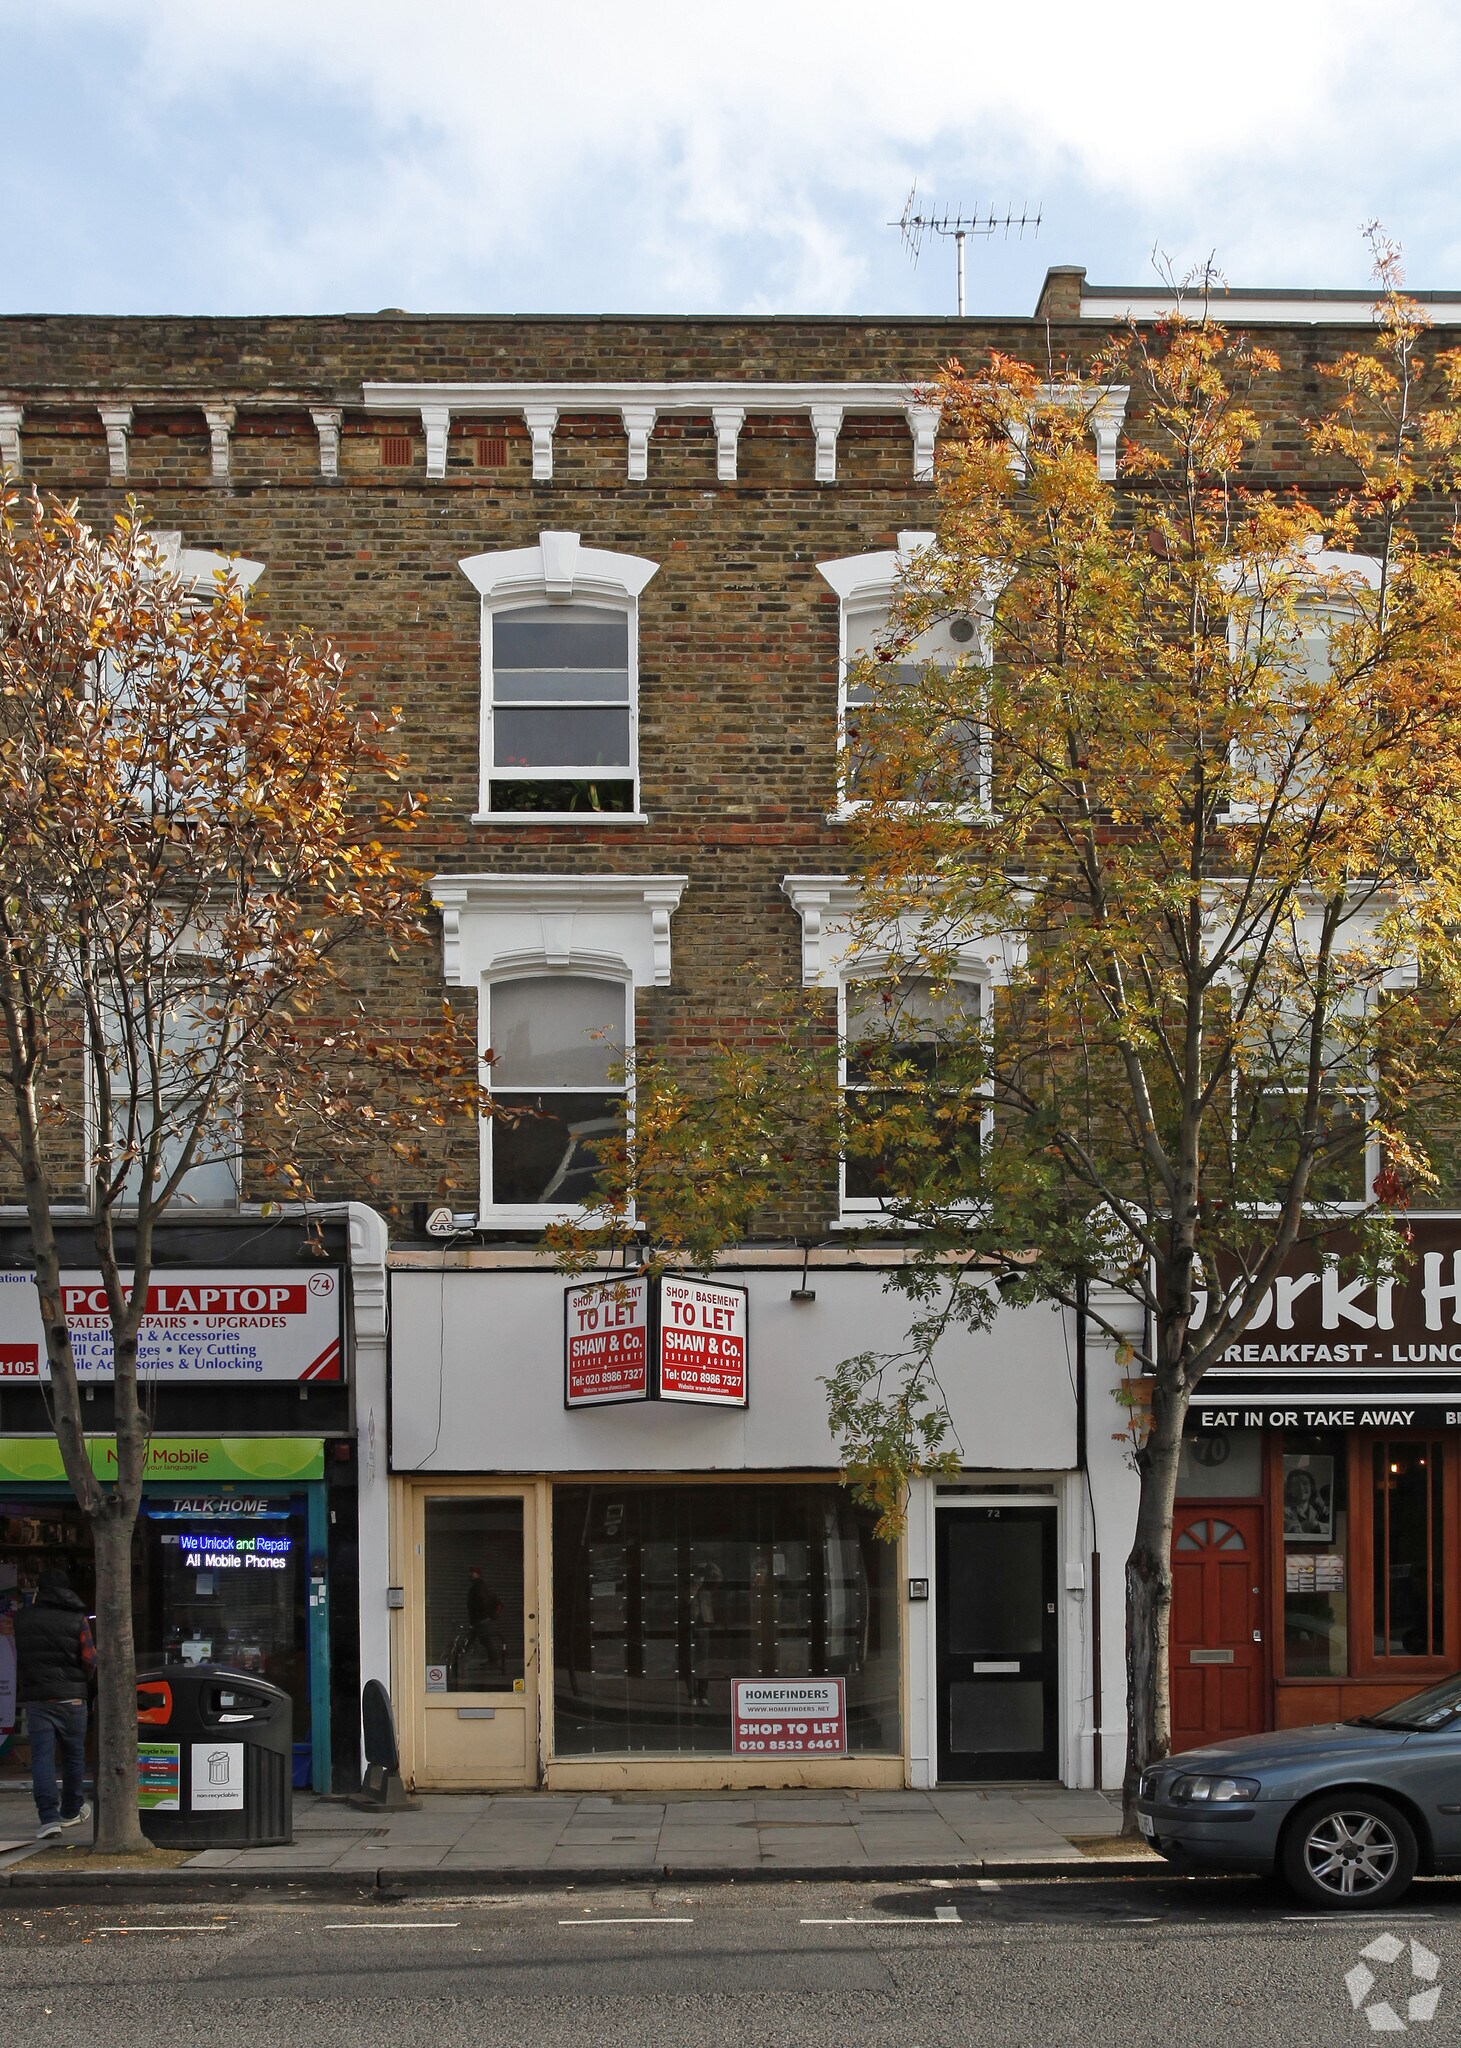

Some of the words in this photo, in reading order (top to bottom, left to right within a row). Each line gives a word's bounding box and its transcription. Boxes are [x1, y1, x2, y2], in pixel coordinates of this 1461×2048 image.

[312, 1279, 330, 1290] 74
[66, 1289, 109, 1312] PC
[157, 1288, 290, 1312] LAPTOP
[573, 1295, 593, 1308] SHOP
[600, 1286, 642, 1303] BASENT
[666, 1286, 689, 1300] SHOP
[696, 1291, 739, 1308] BASEMENT
[67, 1317, 109, 1328] SALES
[139, 1317, 187, 1328] EPAIRS
[206, 1316, 287, 1328] UPGRADES
[578, 1308, 598, 1331] TO
[604, 1301, 637, 1327] LET
[671, 1300, 696, 1326] TO
[702, 1305, 735, 1331] LET
[68, 1329, 143, 1341] Installan
[148, 1330, 158, 1341] &
[162, 1329, 240, 1341] Accessories
[91, 1344, 160, 1358] Carges
[179, 1344, 202, 1358] Key
[207, 1343, 256, 1358] Cutting
[573, 1336, 606, 1357] SHAW
[609, 1334, 619, 1351] &
[623, 1332, 642, 1350] Co.
[665, 1331, 705, 1352] SHAW
[708, 1337, 719, 1354] &
[722, 1339, 740, 1357] Co.
[572, 1357, 601, 1368] ESTATE
[608, 1351, 642, 1363] AGENTS
[665, 1352, 700, 1364] ESTATE
[707, 1357, 741, 1368] AGENTS
[1215, 1344, 1367, 1362] REAKFAST
[97, 1358, 174, 1370] Acsories
[179, 1359, 189, 1369] &
[195, 1357, 263, 1372] Unlocking
[572, 1375, 584, 1387] Tel:
[585, 1373, 599, 1385] 020
[602, 1371, 621, 1383] 8986
[624, 1368, 643, 1380] 7327
[664, 1368, 679, 1380] Tel:
[681, 1370, 698, 1382] 020
[700, 1372, 720, 1385] 8986
[722, 1375, 741, 1387] 7327
[1201, 1411, 1239, 1426] EAT
[1244, 1411, 1263, 1426] IN
[1269, 1411, 1298, 1426] OR
[1303, 1410, 1354, 1425] TAKE
[1359, 1410, 1415, 1425] AWAY
[153, 1449, 208, 1463] Mobile
[1200, 1438, 1225, 1460] 70
[173, 1500, 214, 1512] TALK
[219, 1500, 268, 1512] HOME
[987, 1509, 1000, 1518] 72
[181, 1536, 197, 1549] We
[200, 1536, 234, 1550] Unlock
[236, 1537, 255, 1550] and
[256, 1538, 291, 1553] Repair
[186, 1553, 200, 1567] All
[205, 1554, 241, 1567] Mobile
[245, 1554, 286, 1568] Phones
[745, 1689, 829, 1699] HOMEFINDERS
[740, 1723, 783, 1735] SHOP
[787, 1723, 808, 1734] TO
[813, 1722, 839, 1734] LET
[739, 1741, 765, 1750] 020
[769, 1740, 803, 1750] 8533
[807, 1739, 840, 1749] 6461
